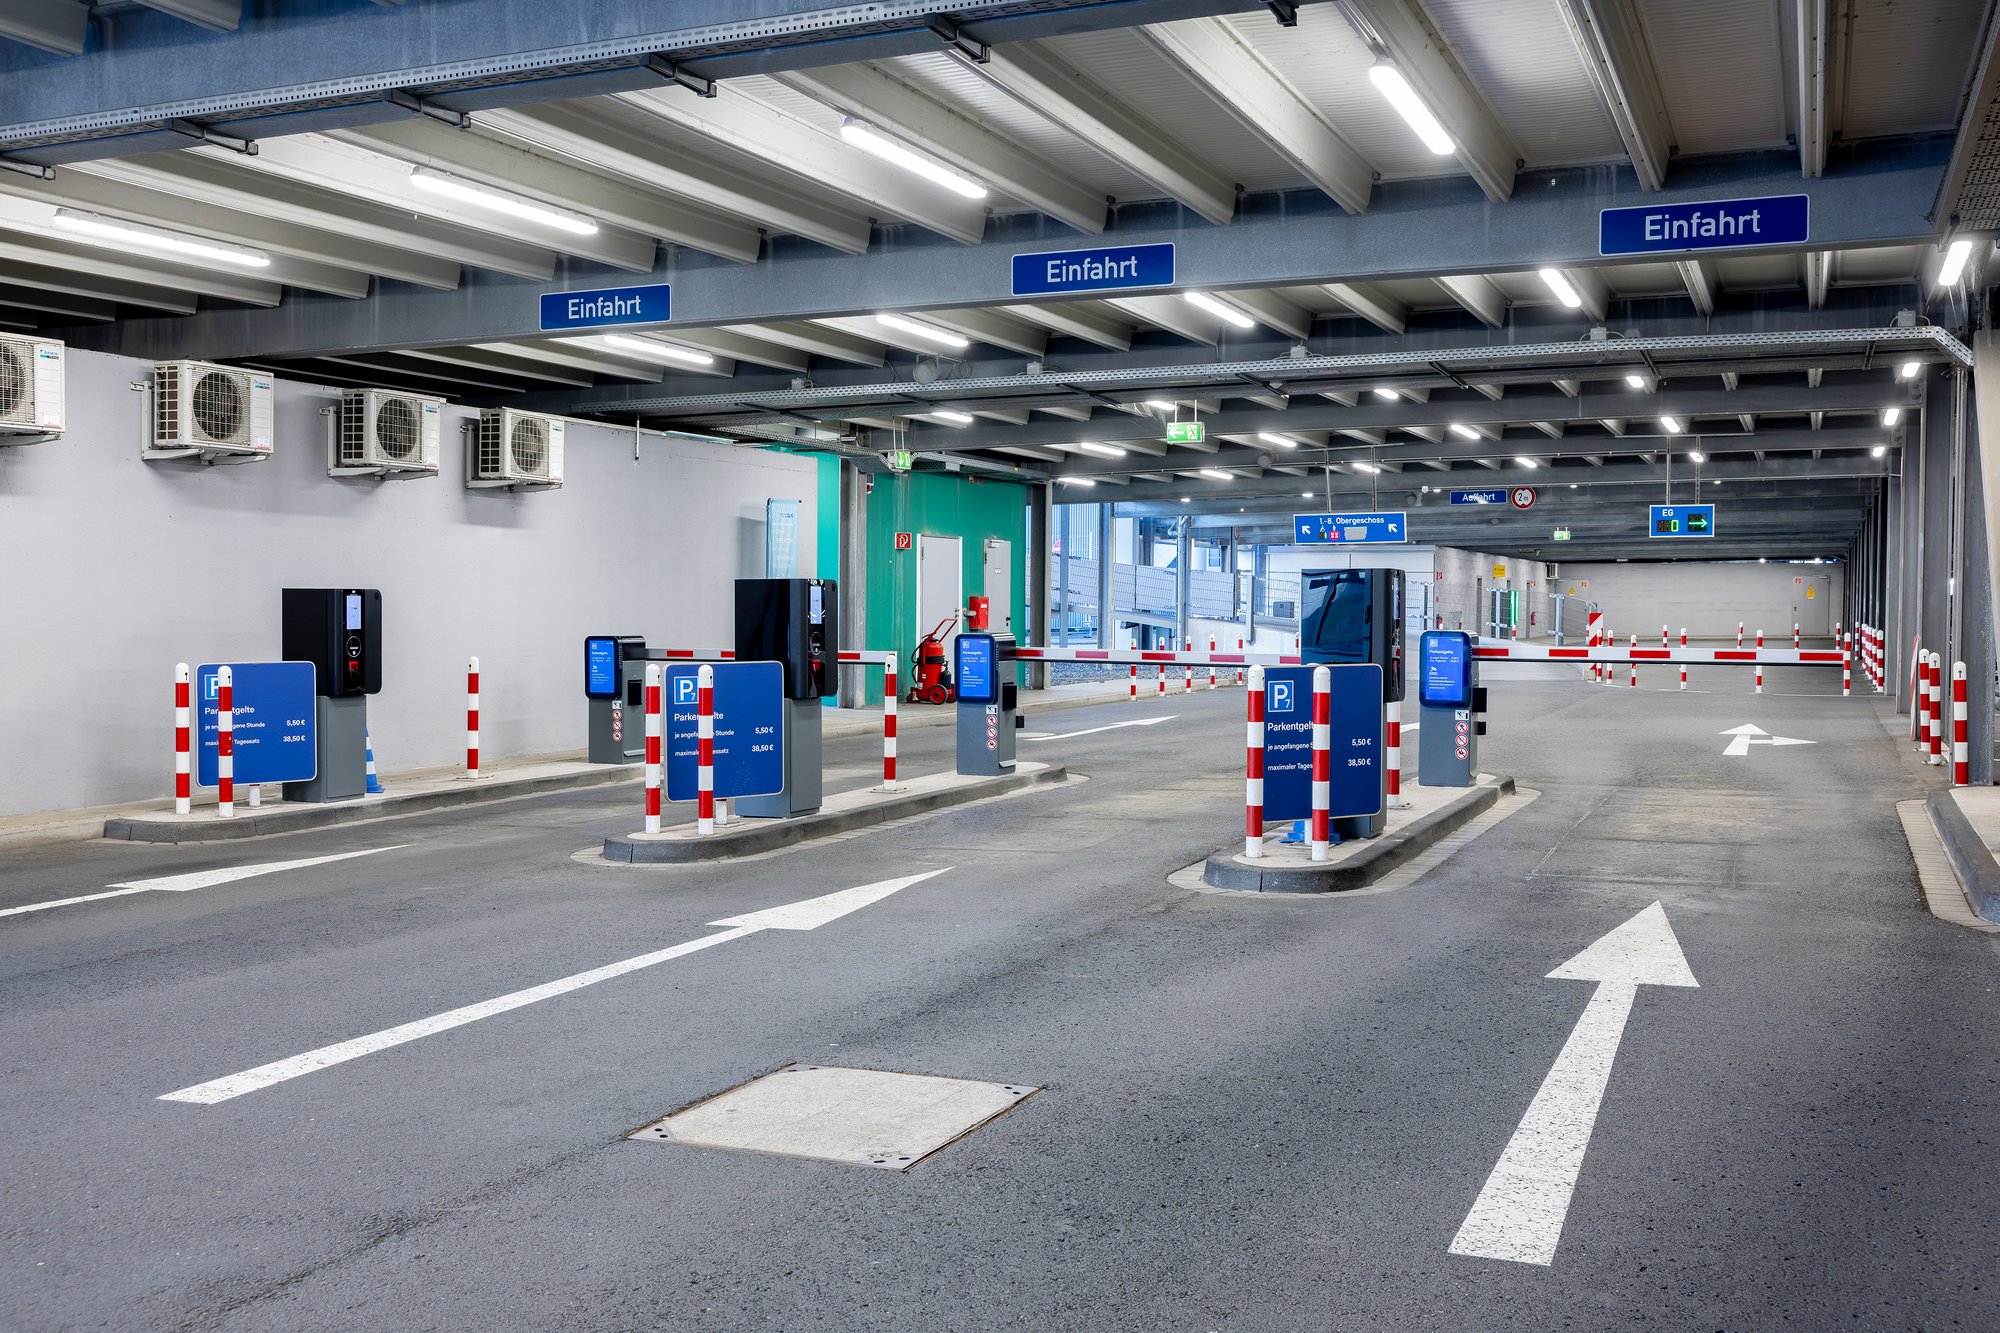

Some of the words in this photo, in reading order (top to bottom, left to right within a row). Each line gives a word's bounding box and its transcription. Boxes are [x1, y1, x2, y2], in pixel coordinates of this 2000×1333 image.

[1645, 209, 1761, 241] Einfahrt
[1047, 255, 1138, 283] Einfahrt
[568, 295, 641, 319] Einfahrt
[1518, 492, 1523, 502] 2
[1662, 509, 1674, 517] EG
[1320, 517, 1334, 525] 1.-8.
[1336, 517, 1385, 525] Obergeschoss
[1671, 520, 1679, 532] 0
[211, 677, 219, 697] P
[205, 706, 255, 716] Partgelte
[674, 712, 724, 722] Parkelte
[287, 719, 300, 727] 5,50
[1268, 721, 1314, 733] Parkentgelt
[681, 731, 714, 739] angefae
[755, 727, 768, 735] 5,50
[234, 738, 260, 746] Tagessatz
[283, 735, 300, 743] 38,50
[1268, 744, 1273, 752] je
[1274, 742, 1309, 752] angefangene
[1352, 739, 1366, 747] 5,50
[1367, 738, 1372, 746] €
[1268, 762, 1297, 771] maximaler
[1297, 762, 1313, 770] Tages
[1347, 759, 1366, 767] 38,50
[1367, 758, 1371, 766] €
